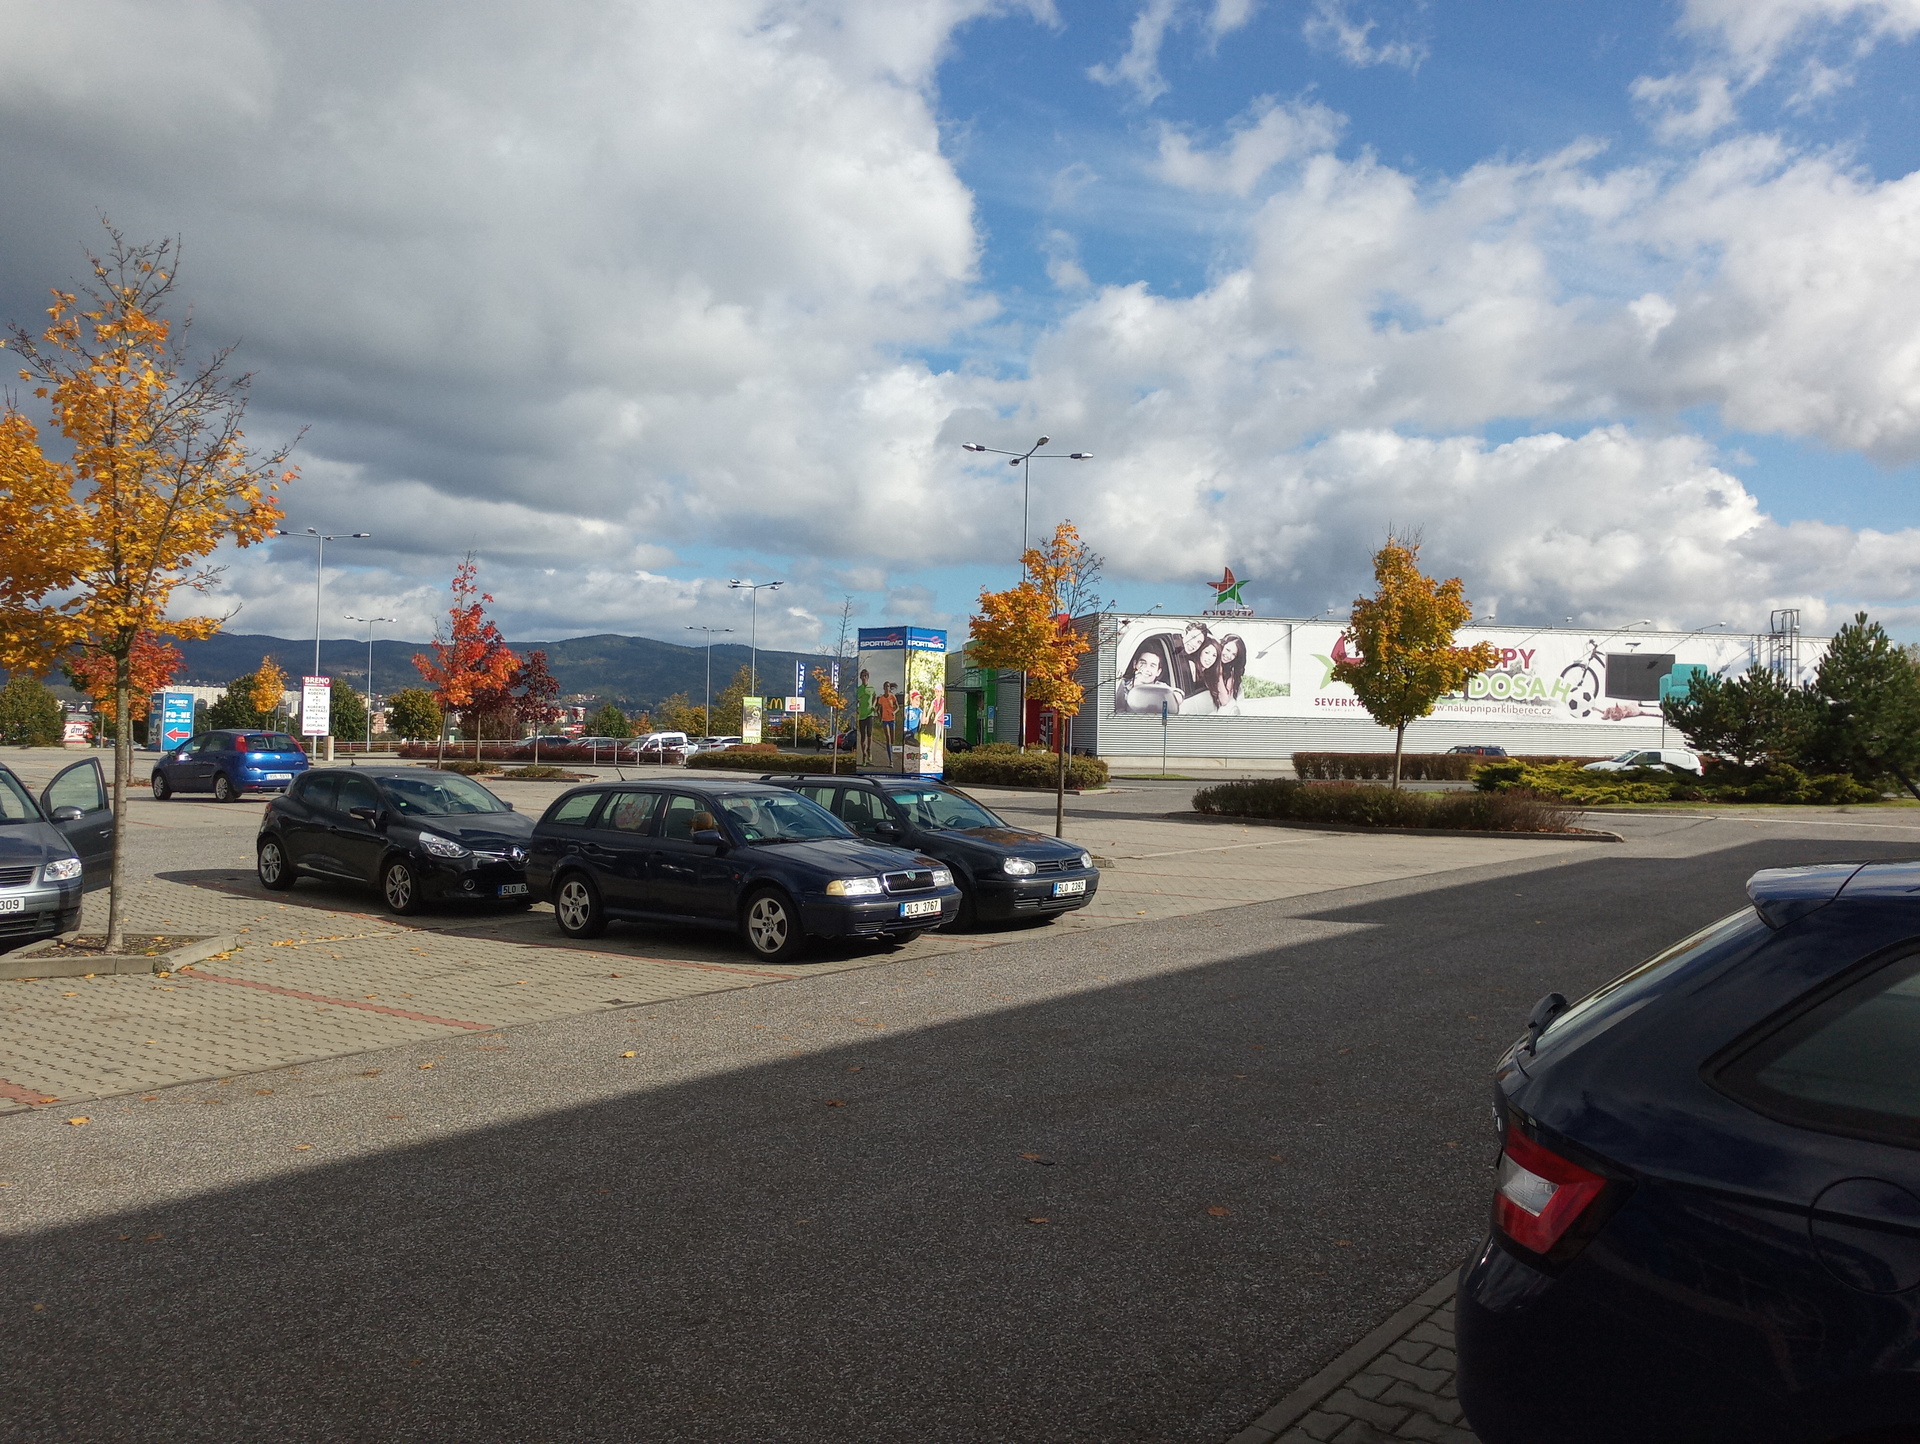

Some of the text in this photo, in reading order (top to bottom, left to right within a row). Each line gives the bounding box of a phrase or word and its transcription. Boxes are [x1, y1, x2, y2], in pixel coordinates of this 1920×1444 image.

[860, 640, 904, 648] SPORTISIMO
[304, 676, 330, 684] BRENO
[70, 725, 83, 734] dm
[906, 900, 938, 914] 3L3 3767
